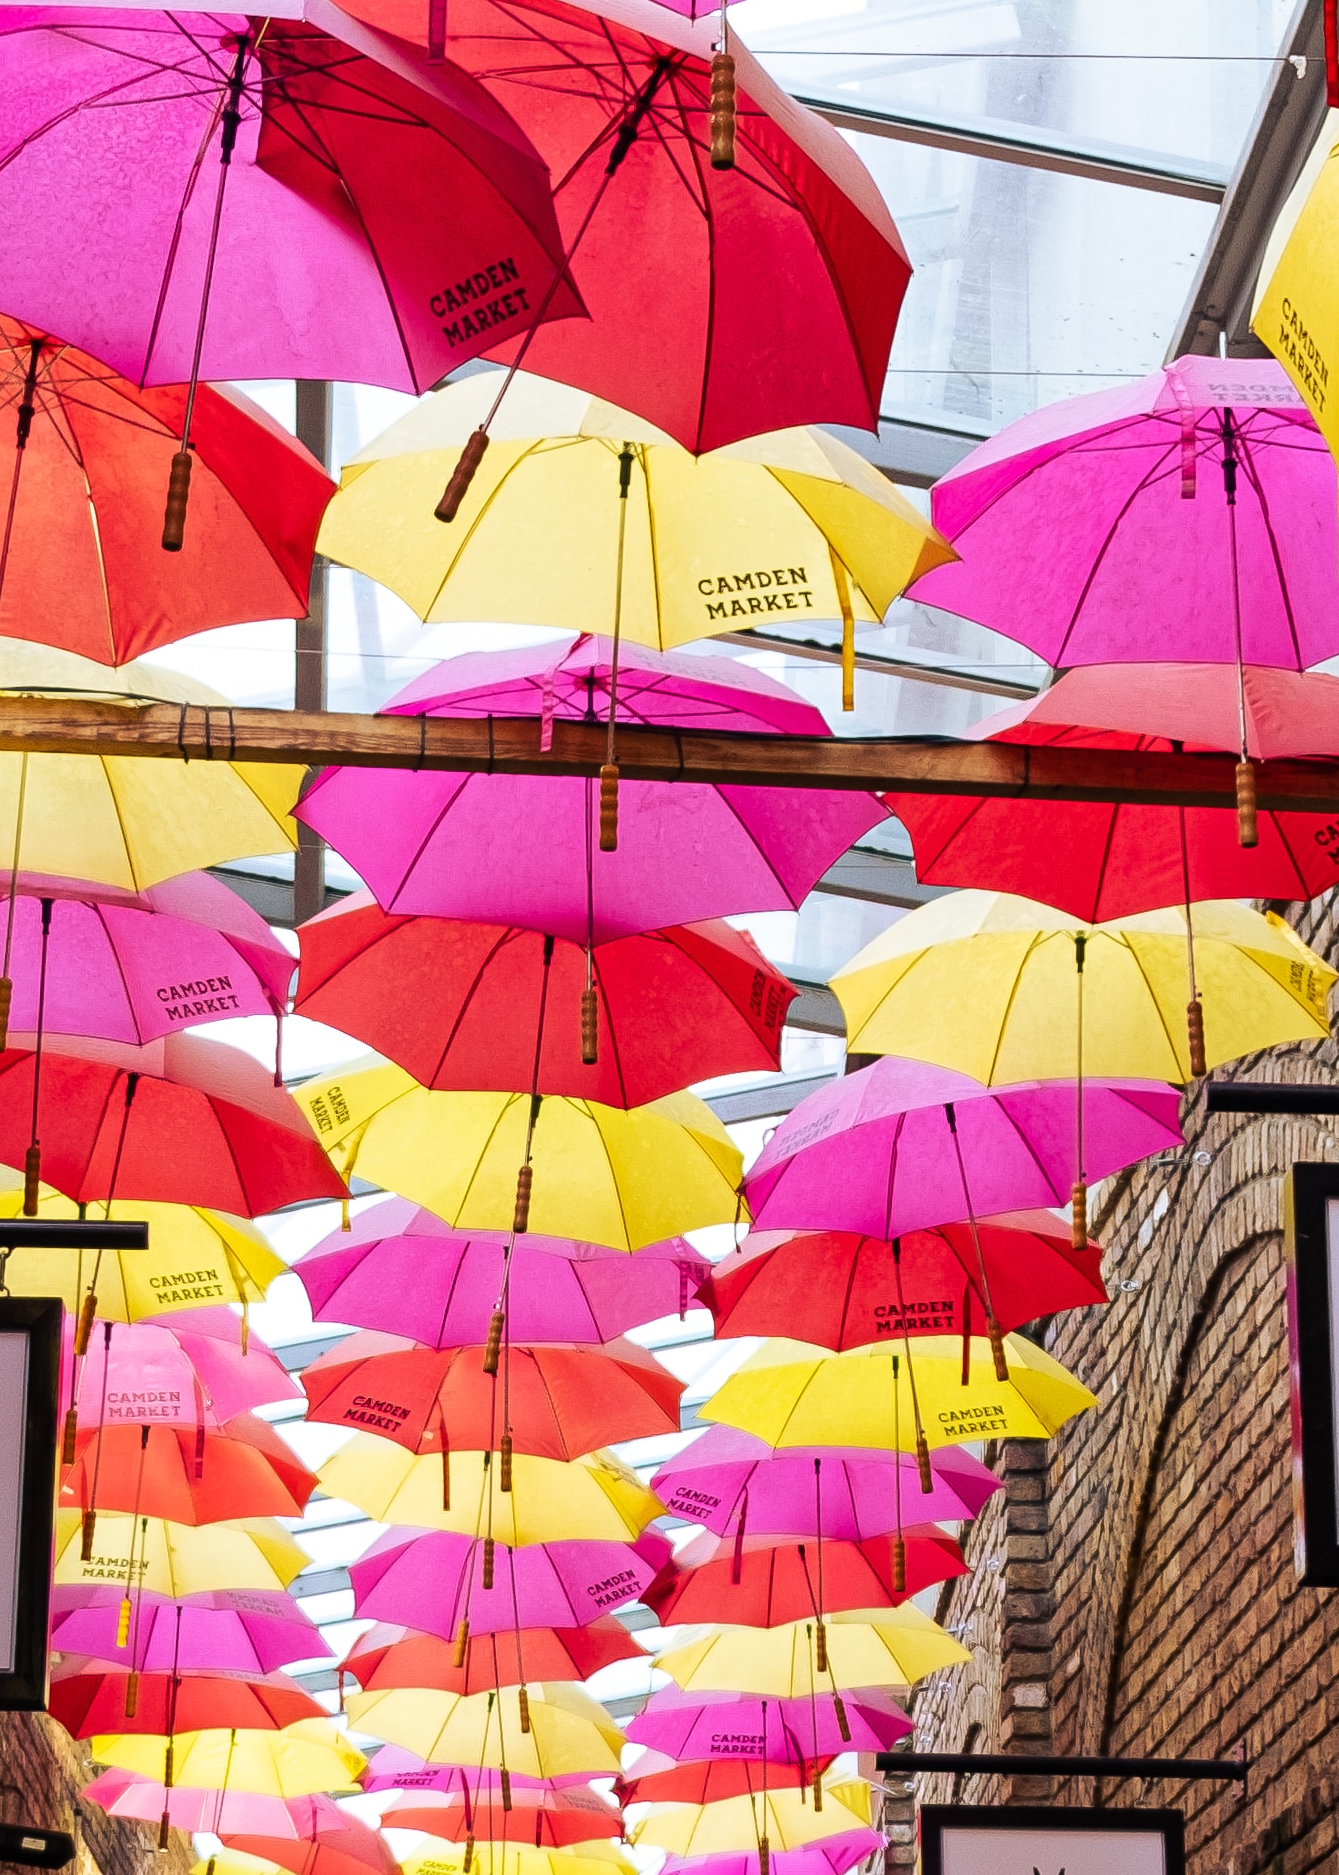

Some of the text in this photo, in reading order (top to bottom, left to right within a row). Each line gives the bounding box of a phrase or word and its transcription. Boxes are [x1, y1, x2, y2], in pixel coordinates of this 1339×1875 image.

[430, 258, 519, 317] CAMDEN
[443, 288, 530, 347] MARKET
[1282, 298, 1329, 387] CAMDEN
[1279, 324, 1326, 413] MARKET
[698, 567, 807, 595] CAMDEN
[706, 592, 812, 619] MARKET
[157, 976, 232, 1002] CAMDEN
[165, 994, 240, 1020] MARKET
[150, 1269, 218, 1288] CAMDEN
[156, 1285, 223, 1303] MARKET
[874, 1301, 954, 1317] CAMDEN
[876, 1316, 954, 1332] MARKET
[107, 1392, 180, 1403] CAMDEN
[353, 1396, 411, 1420] CAMDEN
[109, 1406, 180, 1417] MARKET
[343, 1409, 401, 1432] MARKET
[938, 1405, 1004, 1423] CAMDEN
[944, 1419, 1008, 1436] MARKET
[676, 1487, 721, 1507] CAMDEN
[667, 1498, 712, 1519] MARKET
[82, 1568, 146, 1580] MARKET
[587, 1569, 636, 1596] CAMDEN
[594, 1581, 642, 1608] MARKET
[712, 1734, 767, 1743] CAMDEN
